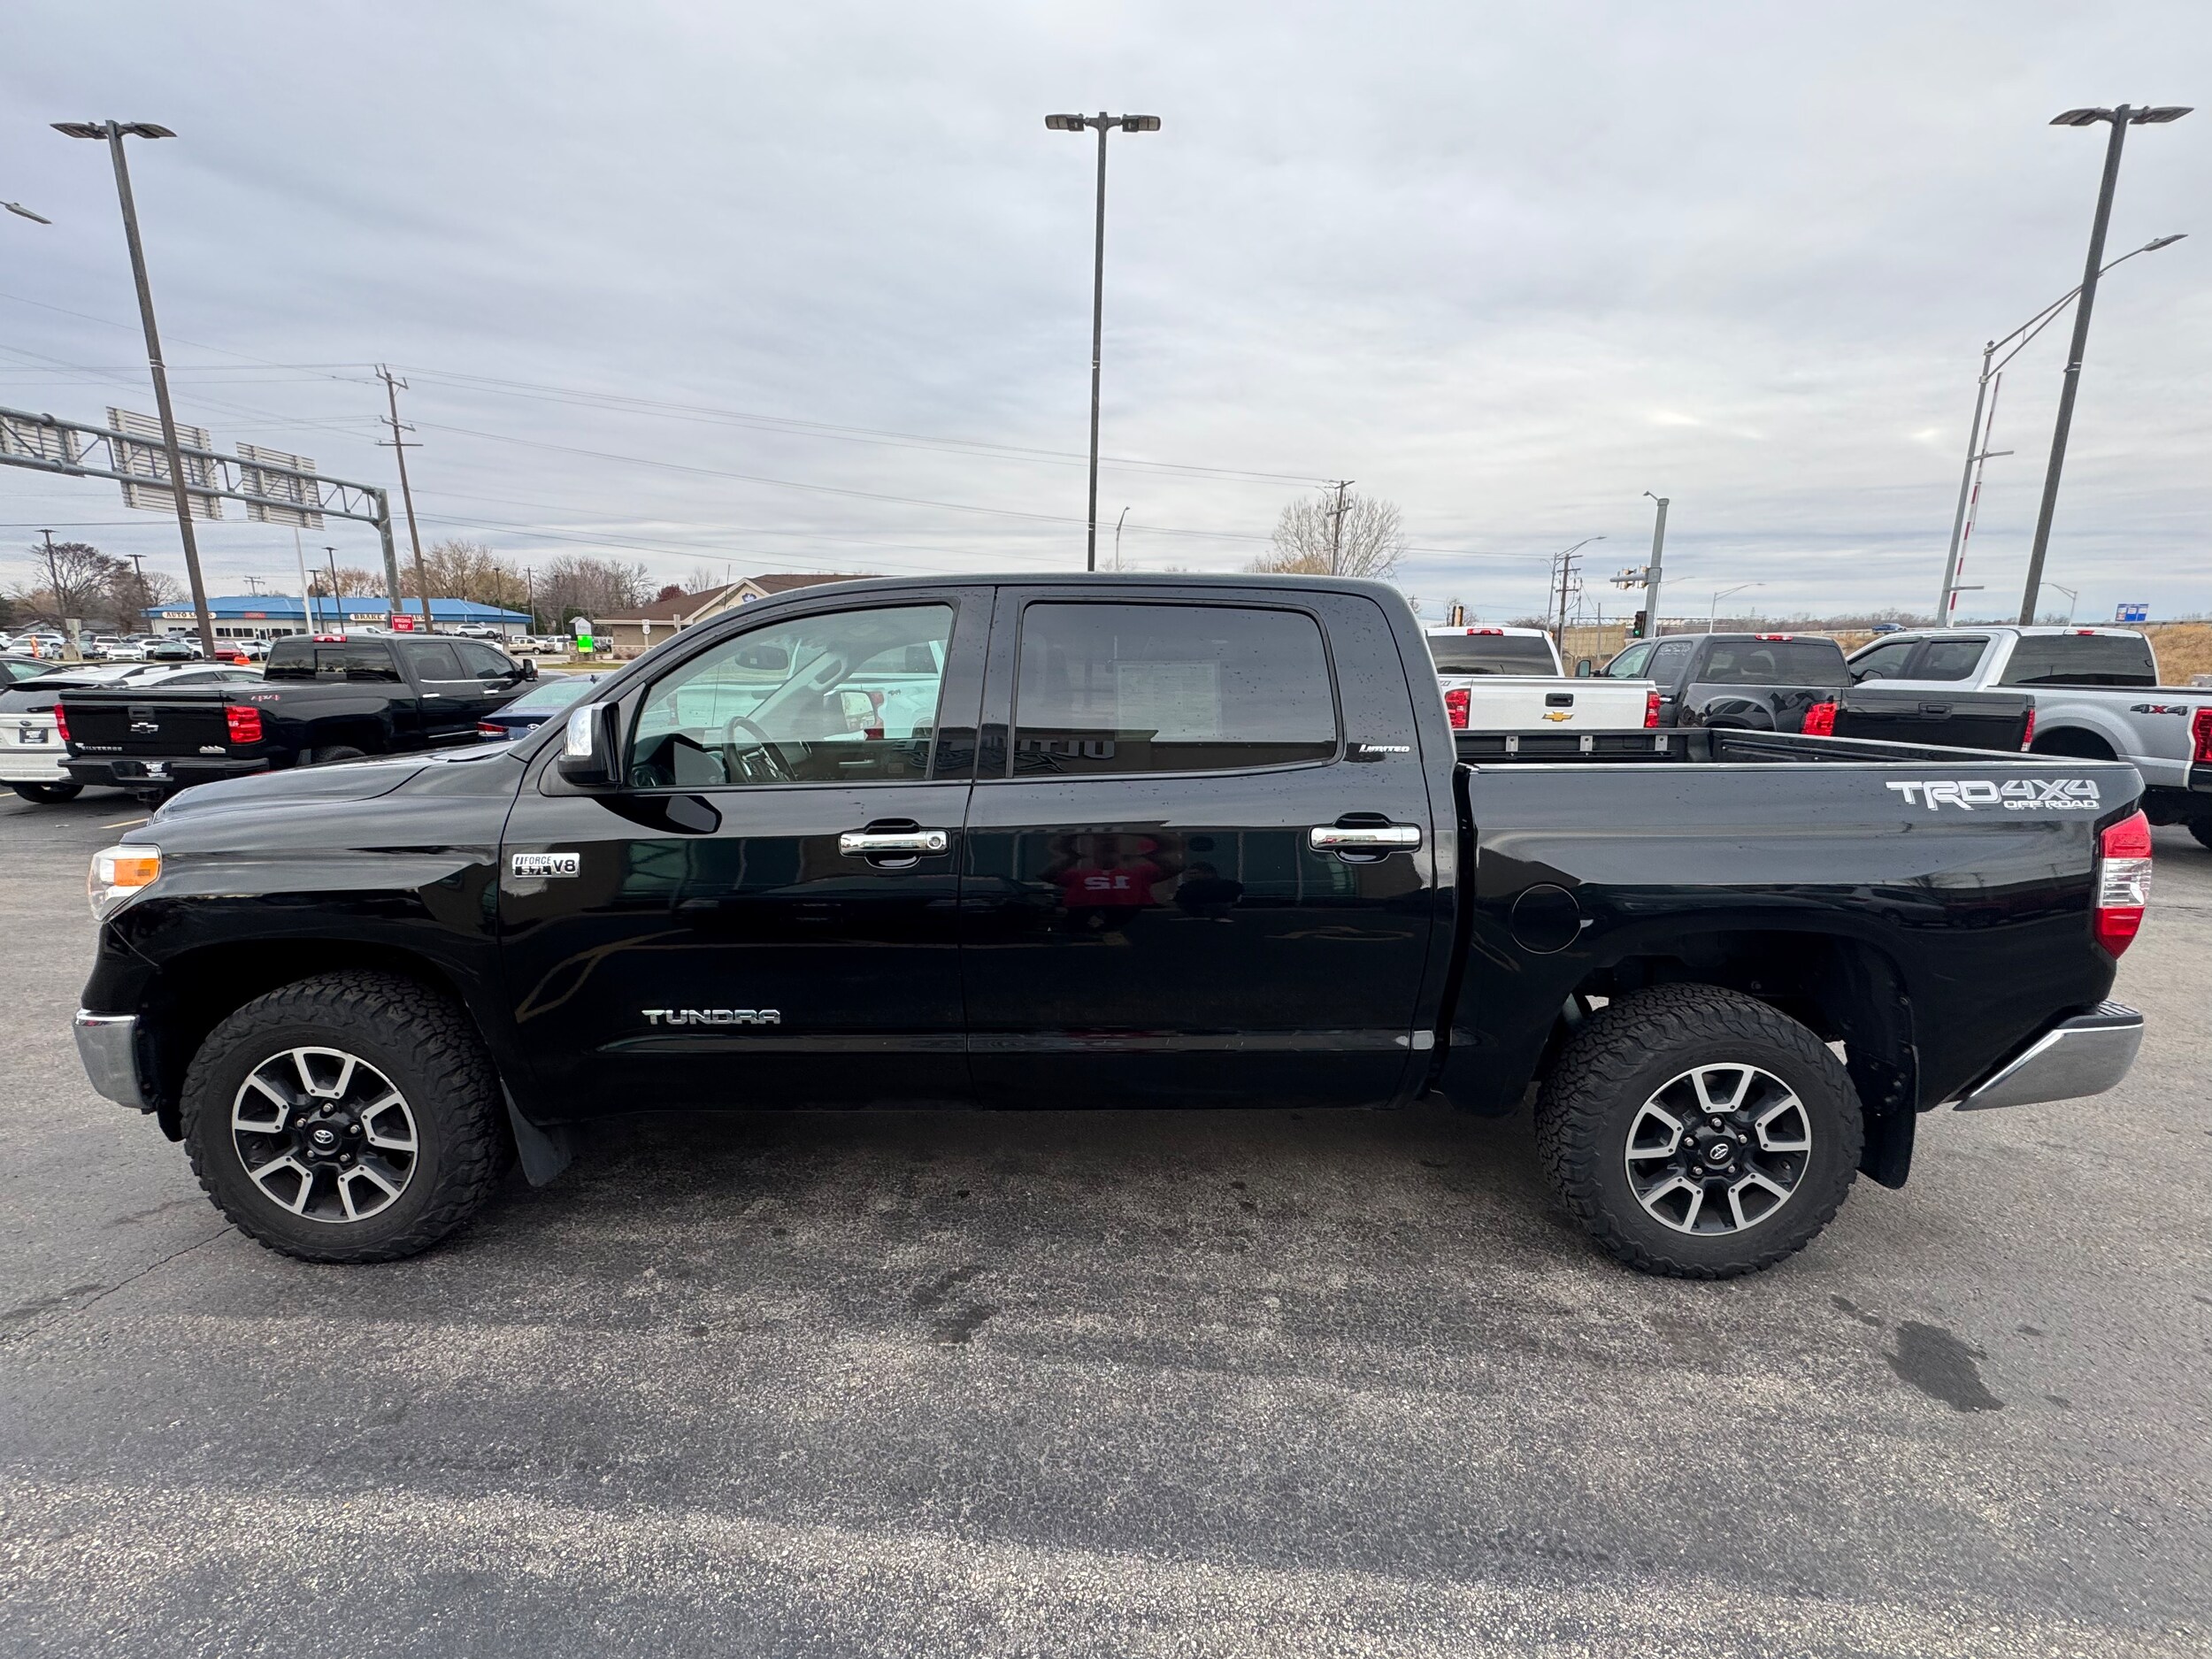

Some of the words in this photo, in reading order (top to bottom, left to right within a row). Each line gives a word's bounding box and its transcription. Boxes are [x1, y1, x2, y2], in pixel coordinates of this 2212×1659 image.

[1359, 744, 1409, 753] LIMITED
[1886, 780, 2001, 810] TRD
[2001, 779, 2101, 800] 4X4
[2003, 799, 2042, 810] OFF
[2044, 799, 2101, 810] ROAD
[553, 859, 576, 874] V8
[641, 1010, 780, 1025] TUNDRA
